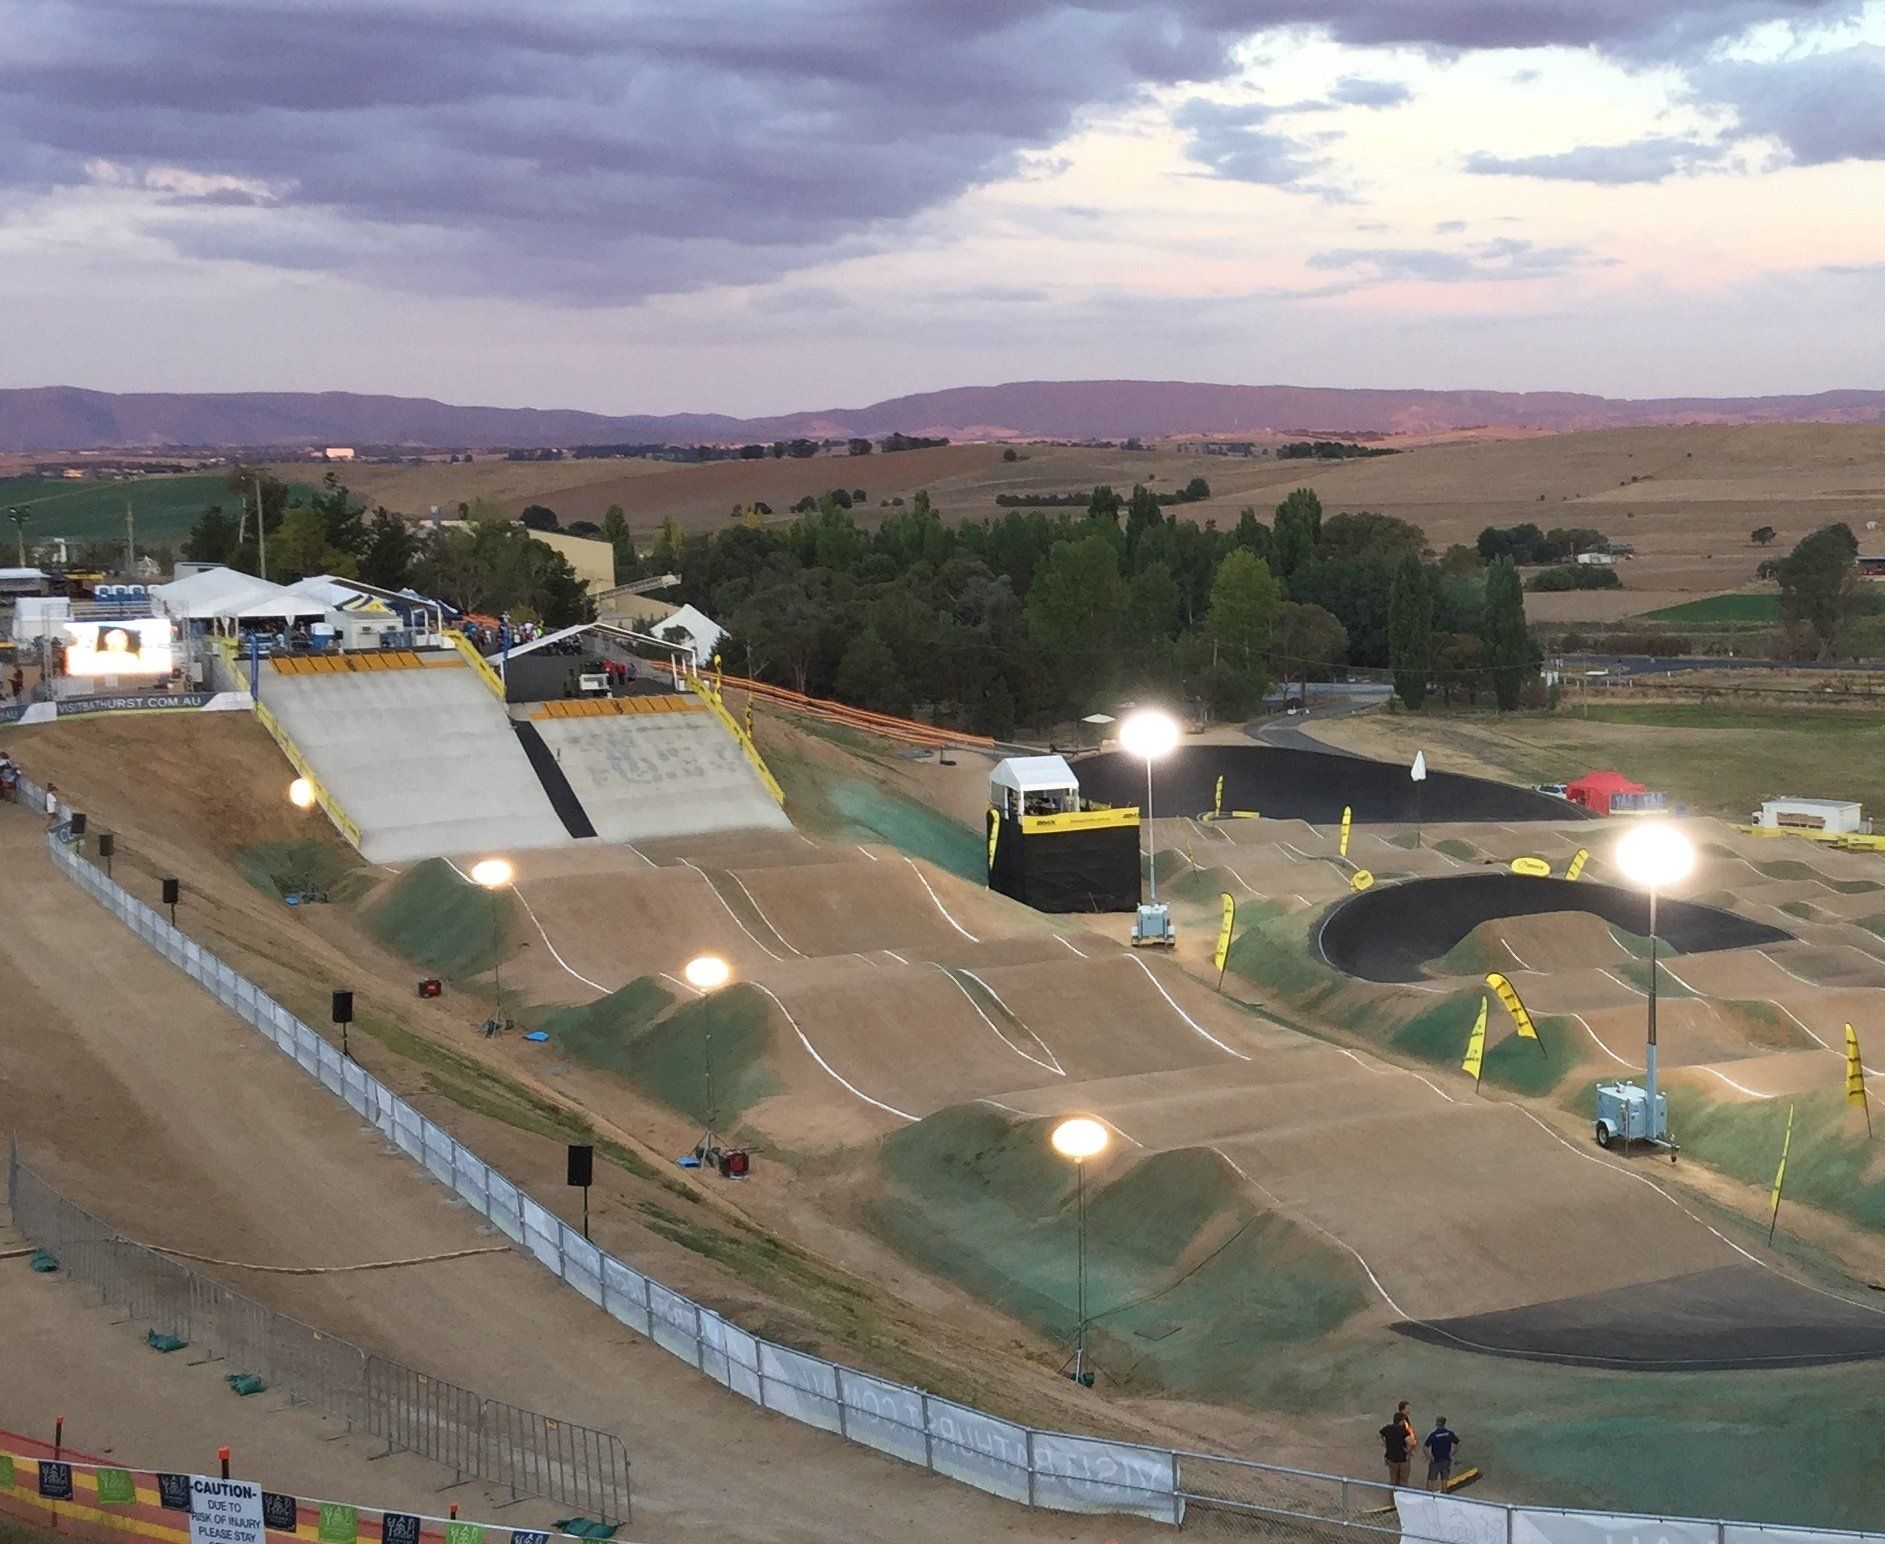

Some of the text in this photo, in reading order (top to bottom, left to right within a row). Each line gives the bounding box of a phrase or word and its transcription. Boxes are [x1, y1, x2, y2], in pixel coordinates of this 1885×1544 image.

[207, 1499, 242, 1513] DUE TO
[214, 1513, 227, 1525] OF
[228, 1515, 261, 1530] INJURY
[198, 1525, 256, 1543] PLEASE STAY
